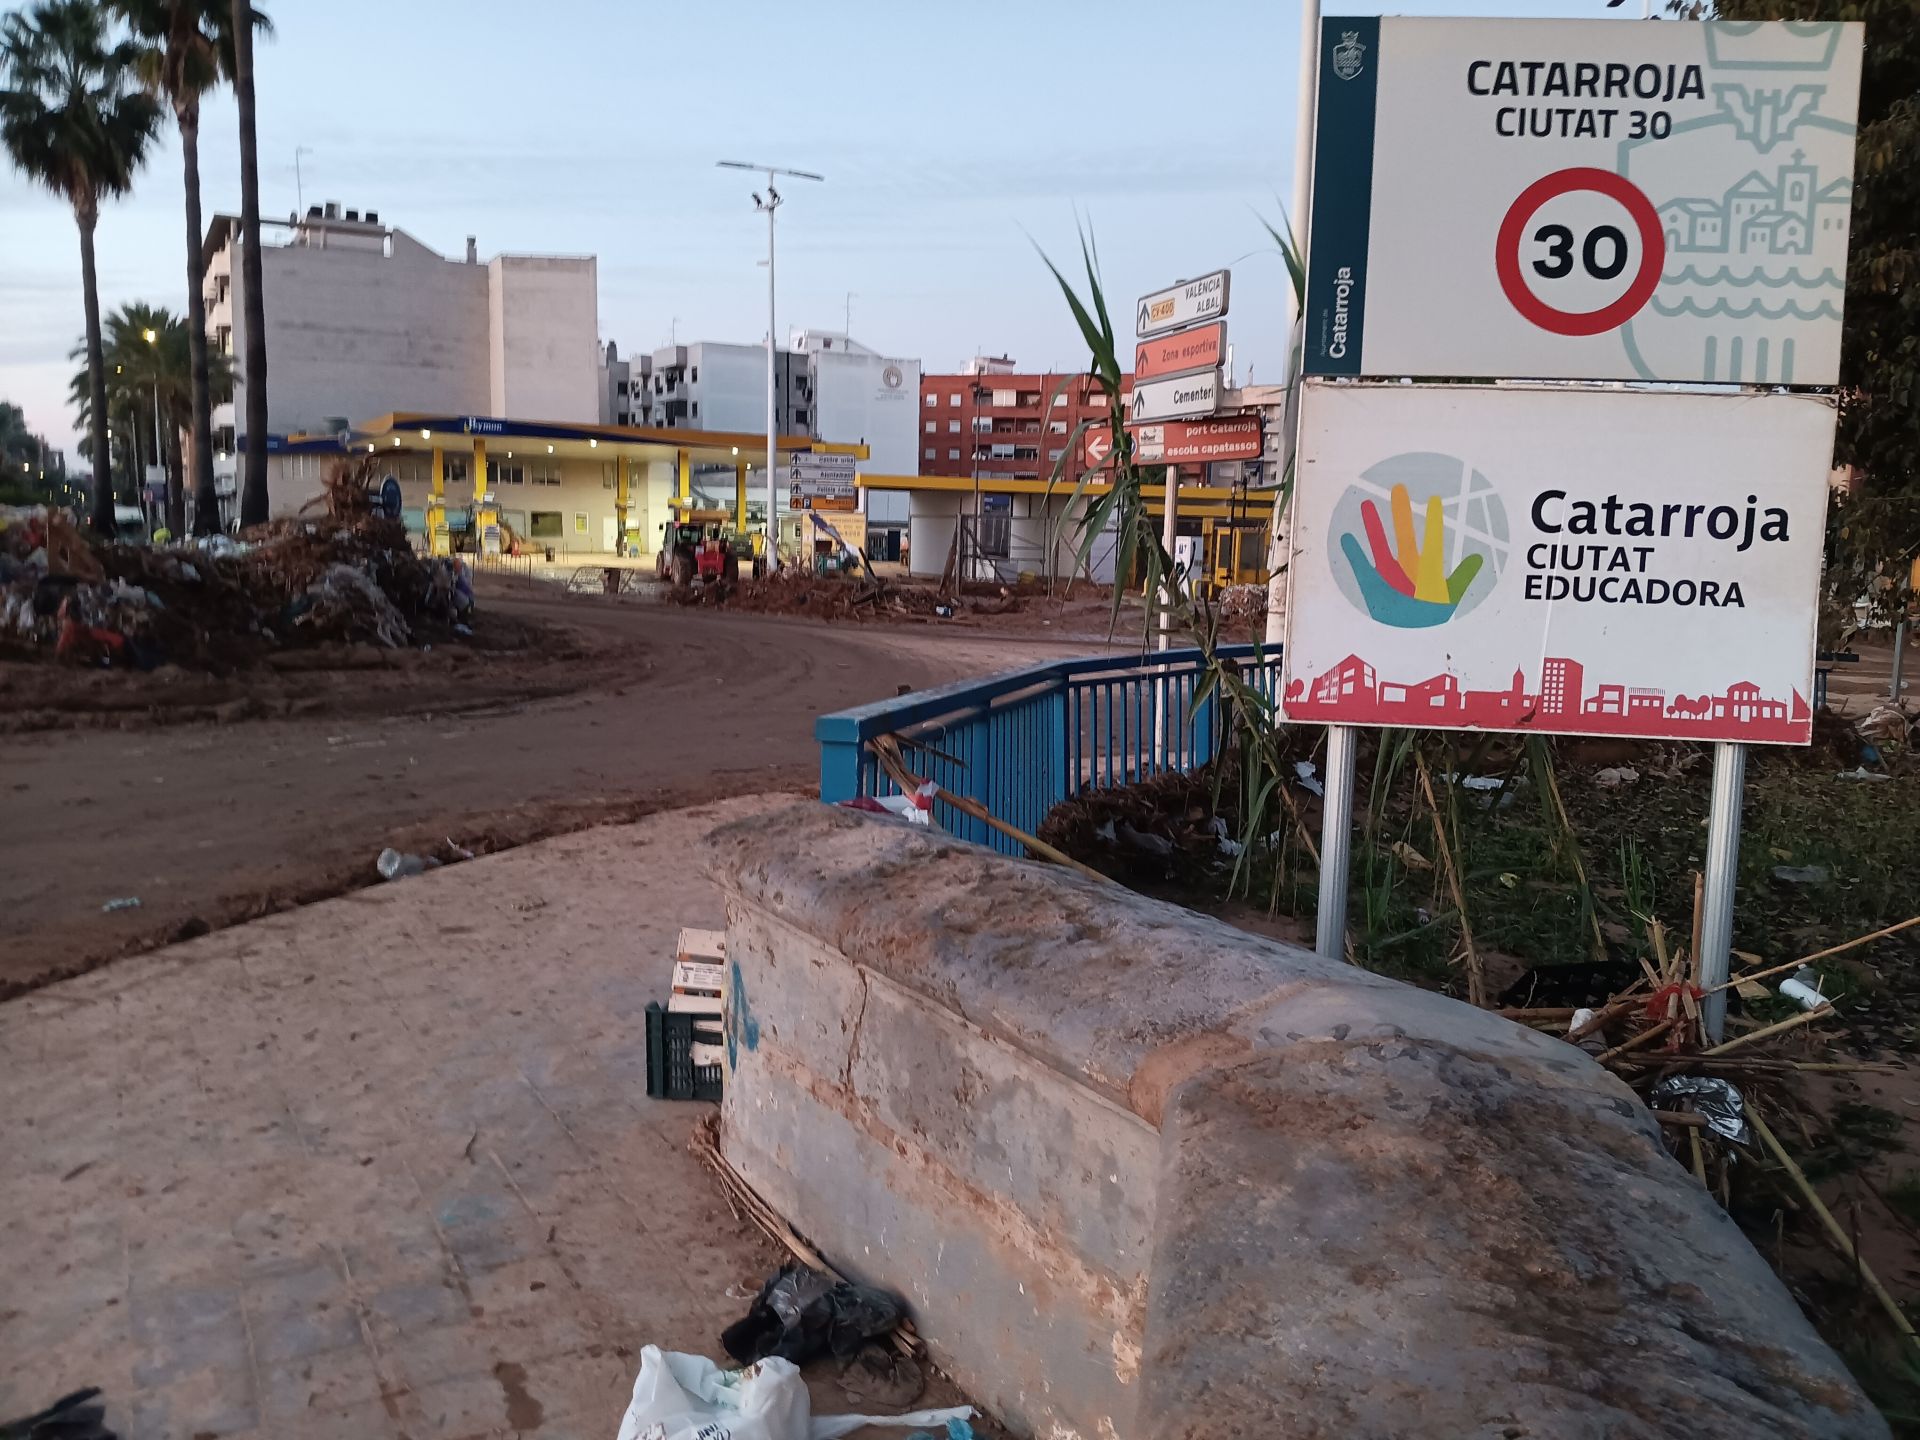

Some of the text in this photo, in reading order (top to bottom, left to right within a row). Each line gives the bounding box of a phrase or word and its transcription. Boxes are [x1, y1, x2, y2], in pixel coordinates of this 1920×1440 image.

[1467, 60, 1704, 101] CATARROJA
[1496, 107, 1672, 140] CIUTAT 30
[1532, 224, 1628, 280] 30
[1196, 296, 1219, 313] ALBAL
[1329, 267, 1355, 358] Catarroja
[1162, 339, 1217, 362] Zona esportiva
[1173, 384, 1214, 404] Cementeri
[1186, 421, 1257, 437] port Catarroja
[1167, 441, 1257, 456] escola capatassos
[1530, 489, 1790, 551] Catarroja
[1526, 544, 1655, 573] CIUTAT
[1524, 574, 1745, 608] EDUCADORA
